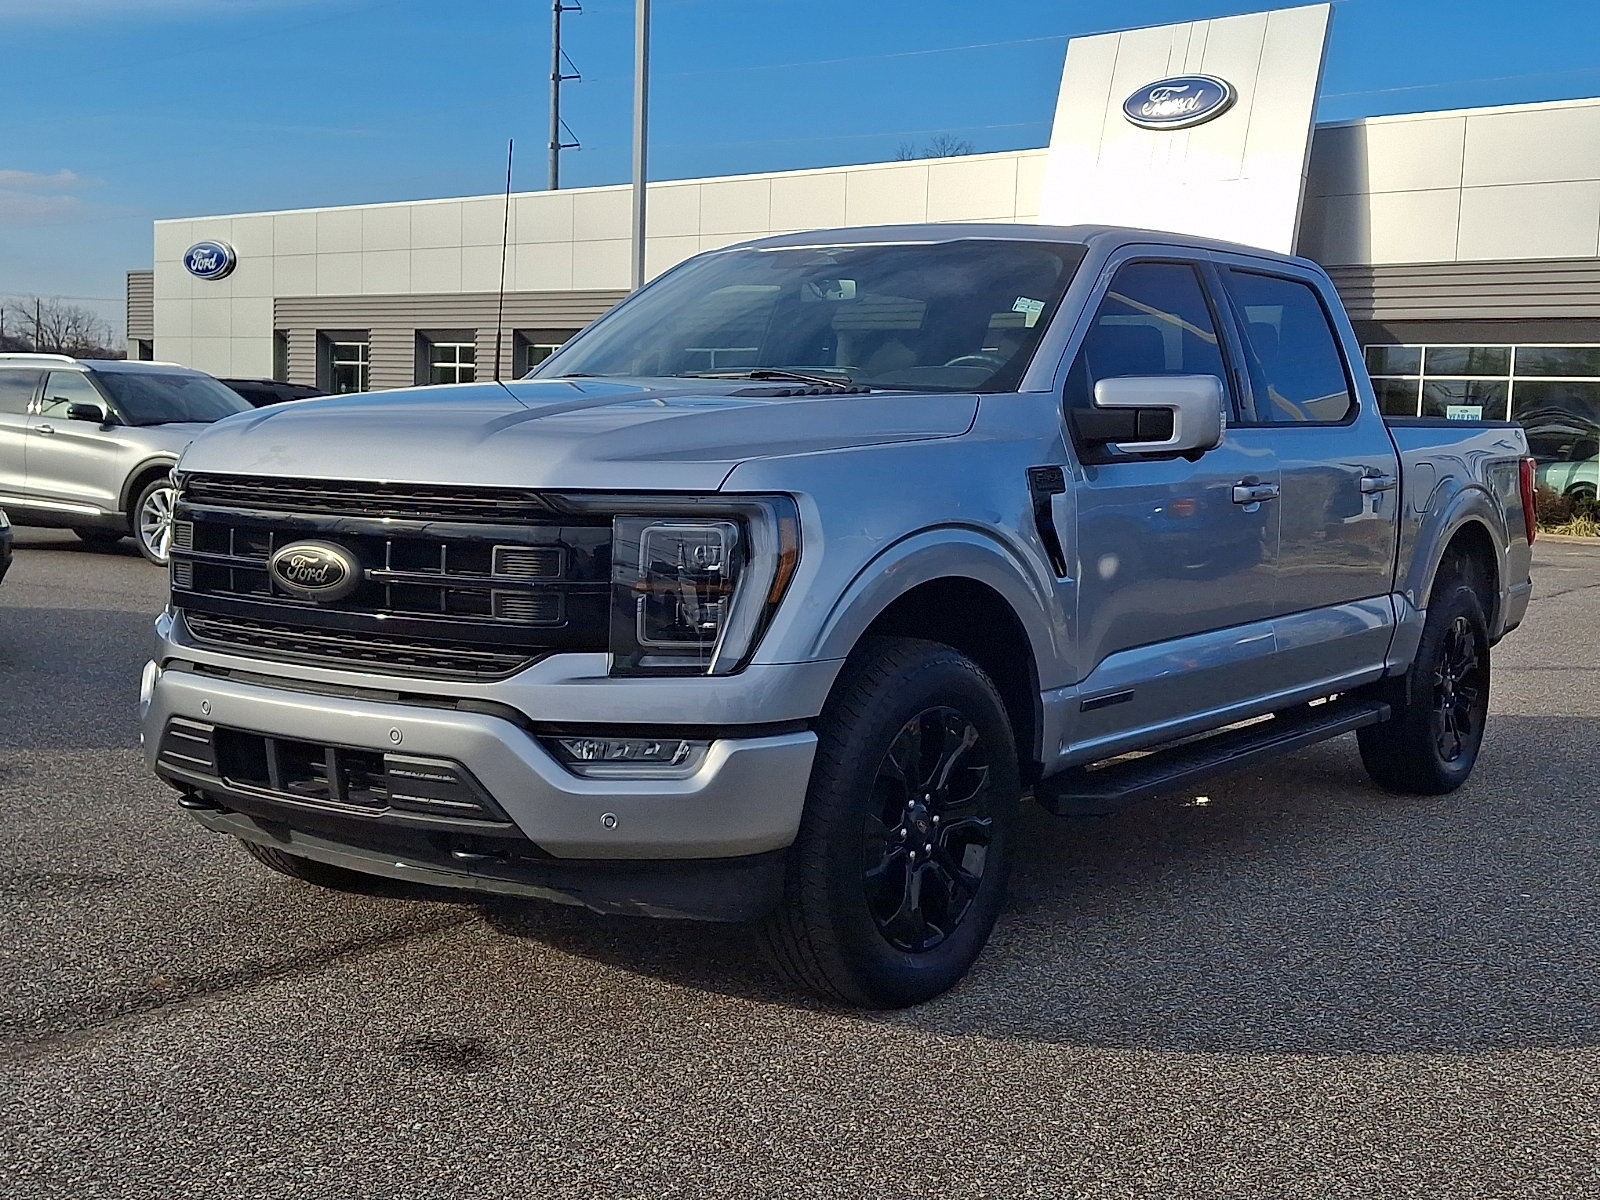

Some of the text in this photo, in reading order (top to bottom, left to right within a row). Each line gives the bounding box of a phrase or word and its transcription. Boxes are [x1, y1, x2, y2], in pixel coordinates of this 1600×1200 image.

[1141, 85, 1204, 116] Ford
[190, 248, 218, 271] Ford
[286, 554, 329, 583] Ford
